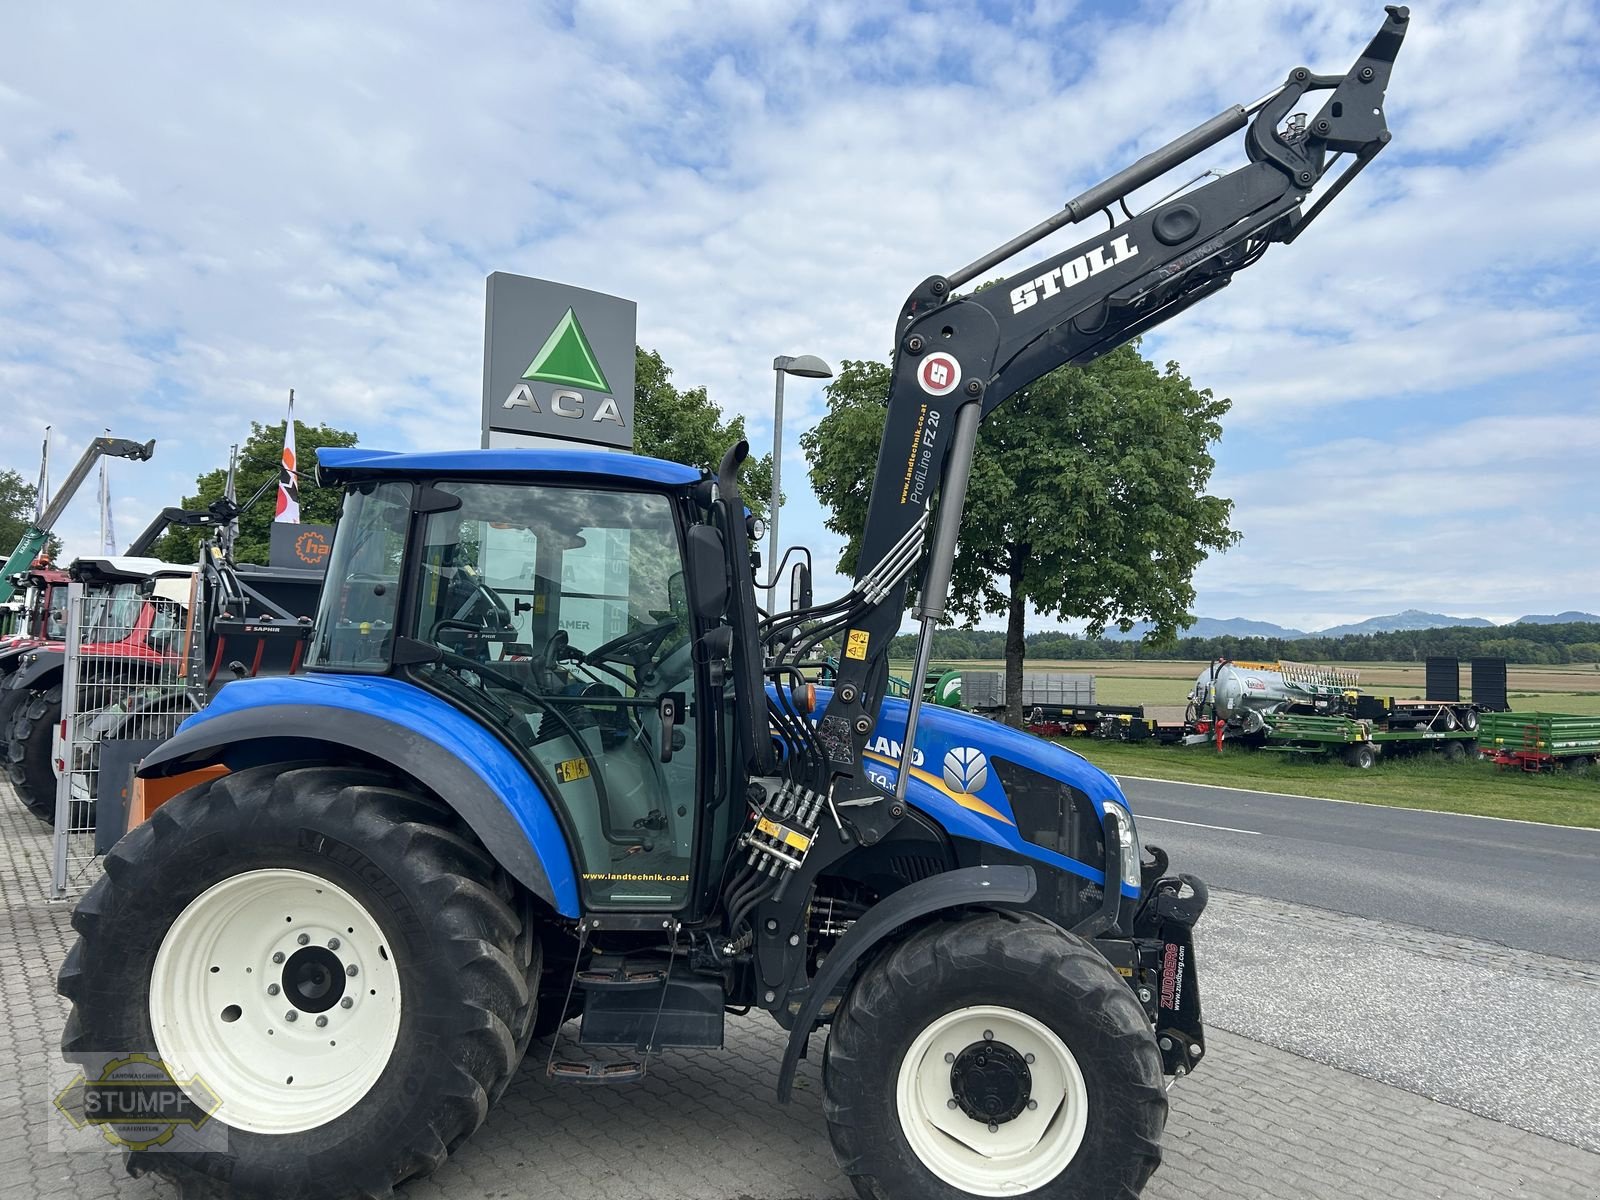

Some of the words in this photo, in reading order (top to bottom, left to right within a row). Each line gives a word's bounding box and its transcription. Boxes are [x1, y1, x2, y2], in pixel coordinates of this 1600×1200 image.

[1009, 233, 1140, 315] STOLL
[501, 383, 626, 428] ACA
[928, 410, 941, 429] 20
[900, 403, 928, 504] www.landtechnik.co.at
[922, 430, 938, 448] FZ
[910, 451, 932, 504] ProfiLine
[582, 873, 690, 881] www.landtechnik.co.at
[1161, 943, 1178, 1009] ZUIDBERG
[1174, 945, 1185, 1011] www.zuidberg.com
